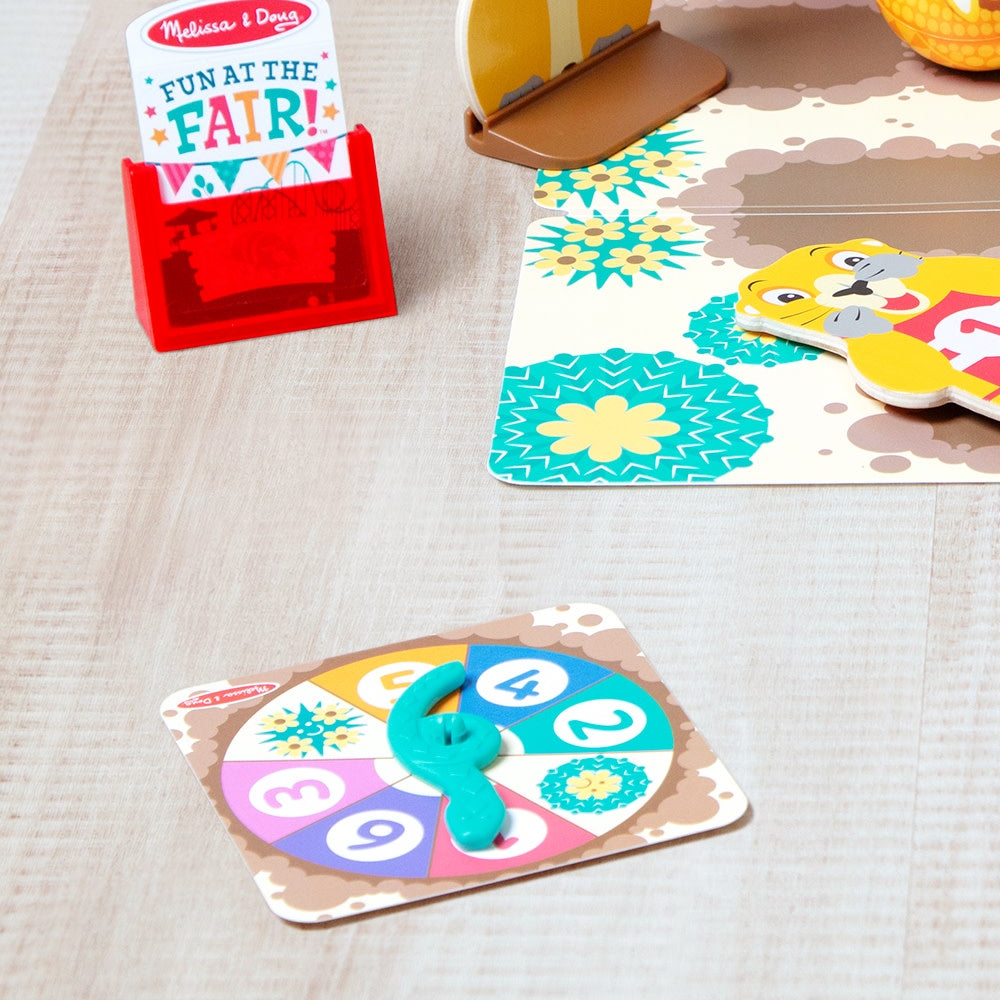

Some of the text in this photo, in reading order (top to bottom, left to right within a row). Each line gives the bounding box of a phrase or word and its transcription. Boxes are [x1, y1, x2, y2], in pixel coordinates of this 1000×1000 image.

[160, 8, 299, 42] Melissa & Doug
[159, 60, 319, 103] FUN AT THE
[166, 87, 319, 155] FAIR!
[182, 696, 212, 706] Doug
[222, 685, 269, 698] Melissa
[492, 668, 541, 702] 4
[566, 708, 635, 742] 2
[261, 778, 331, 809] 3
